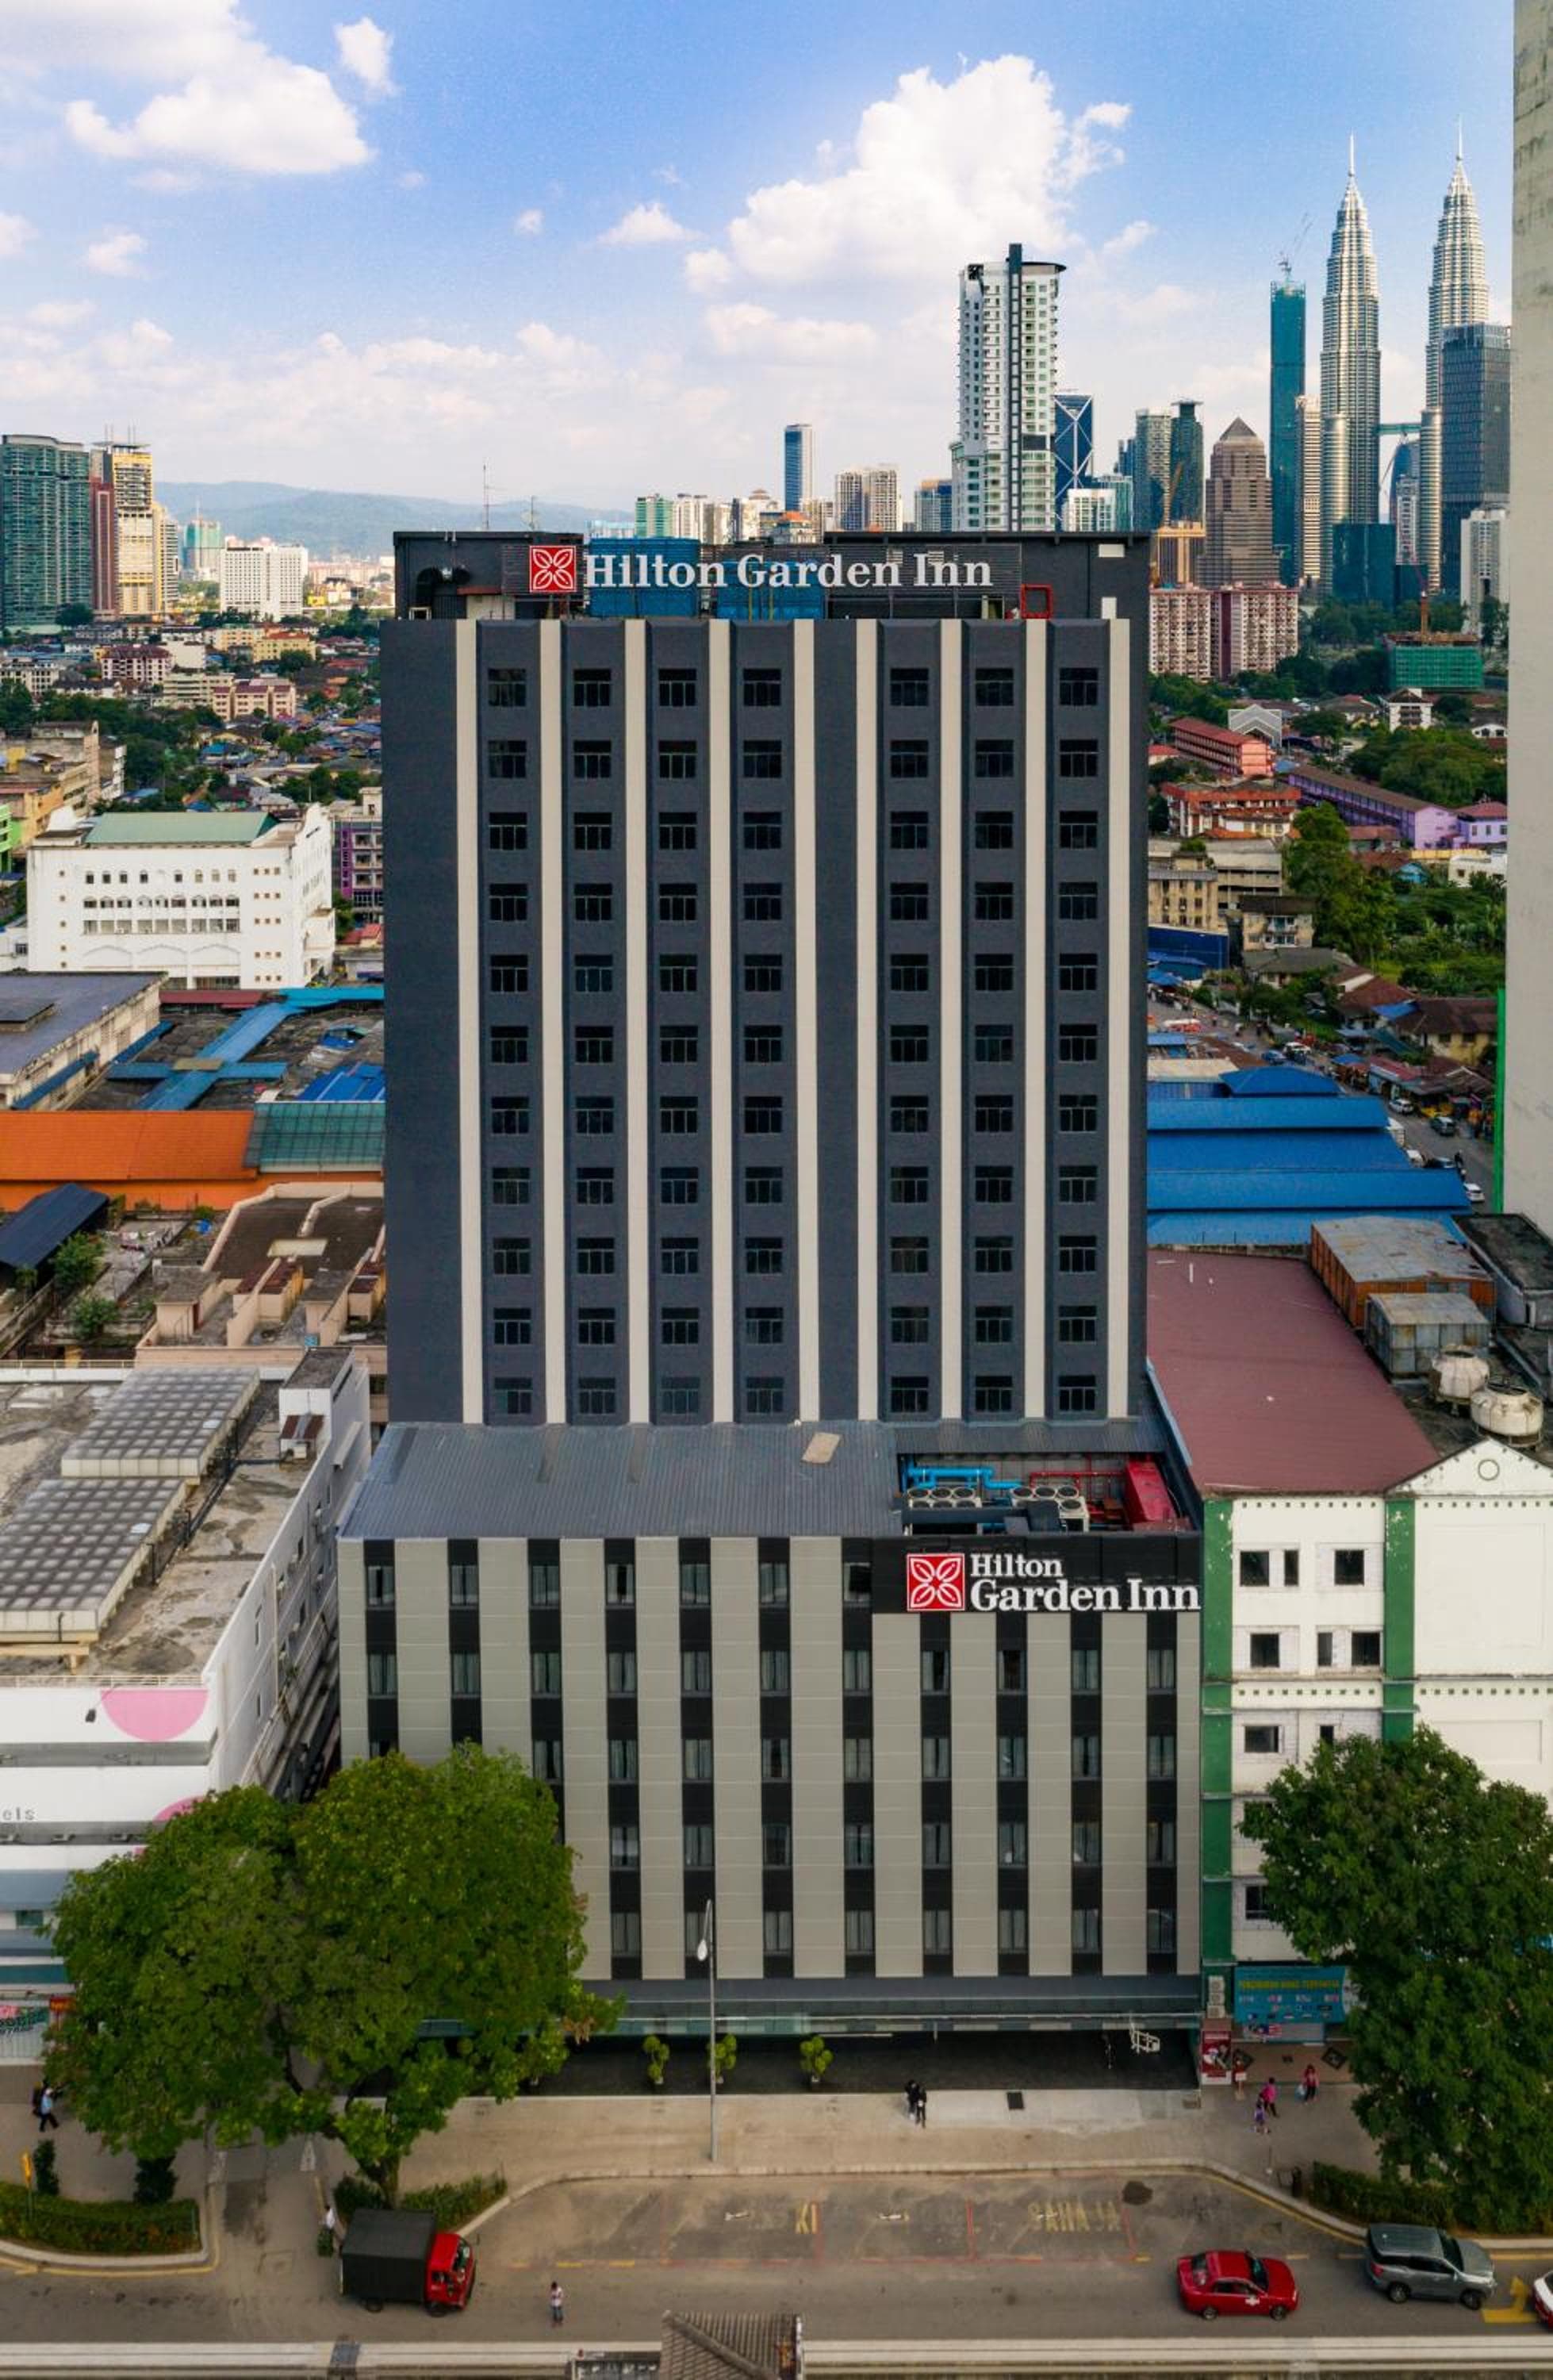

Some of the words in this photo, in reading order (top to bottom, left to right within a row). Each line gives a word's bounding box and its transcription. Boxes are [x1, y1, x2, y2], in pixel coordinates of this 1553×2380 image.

[583, 555, 727, 588] Hilton
[737, 555, 901, 588] Garden
[913, 555, 993, 588] Inn
[970, 1553, 1064, 1577] Hilton
[970, 1579, 1122, 1611] Garden
[1127, 1579, 1202, 1610] Inn
